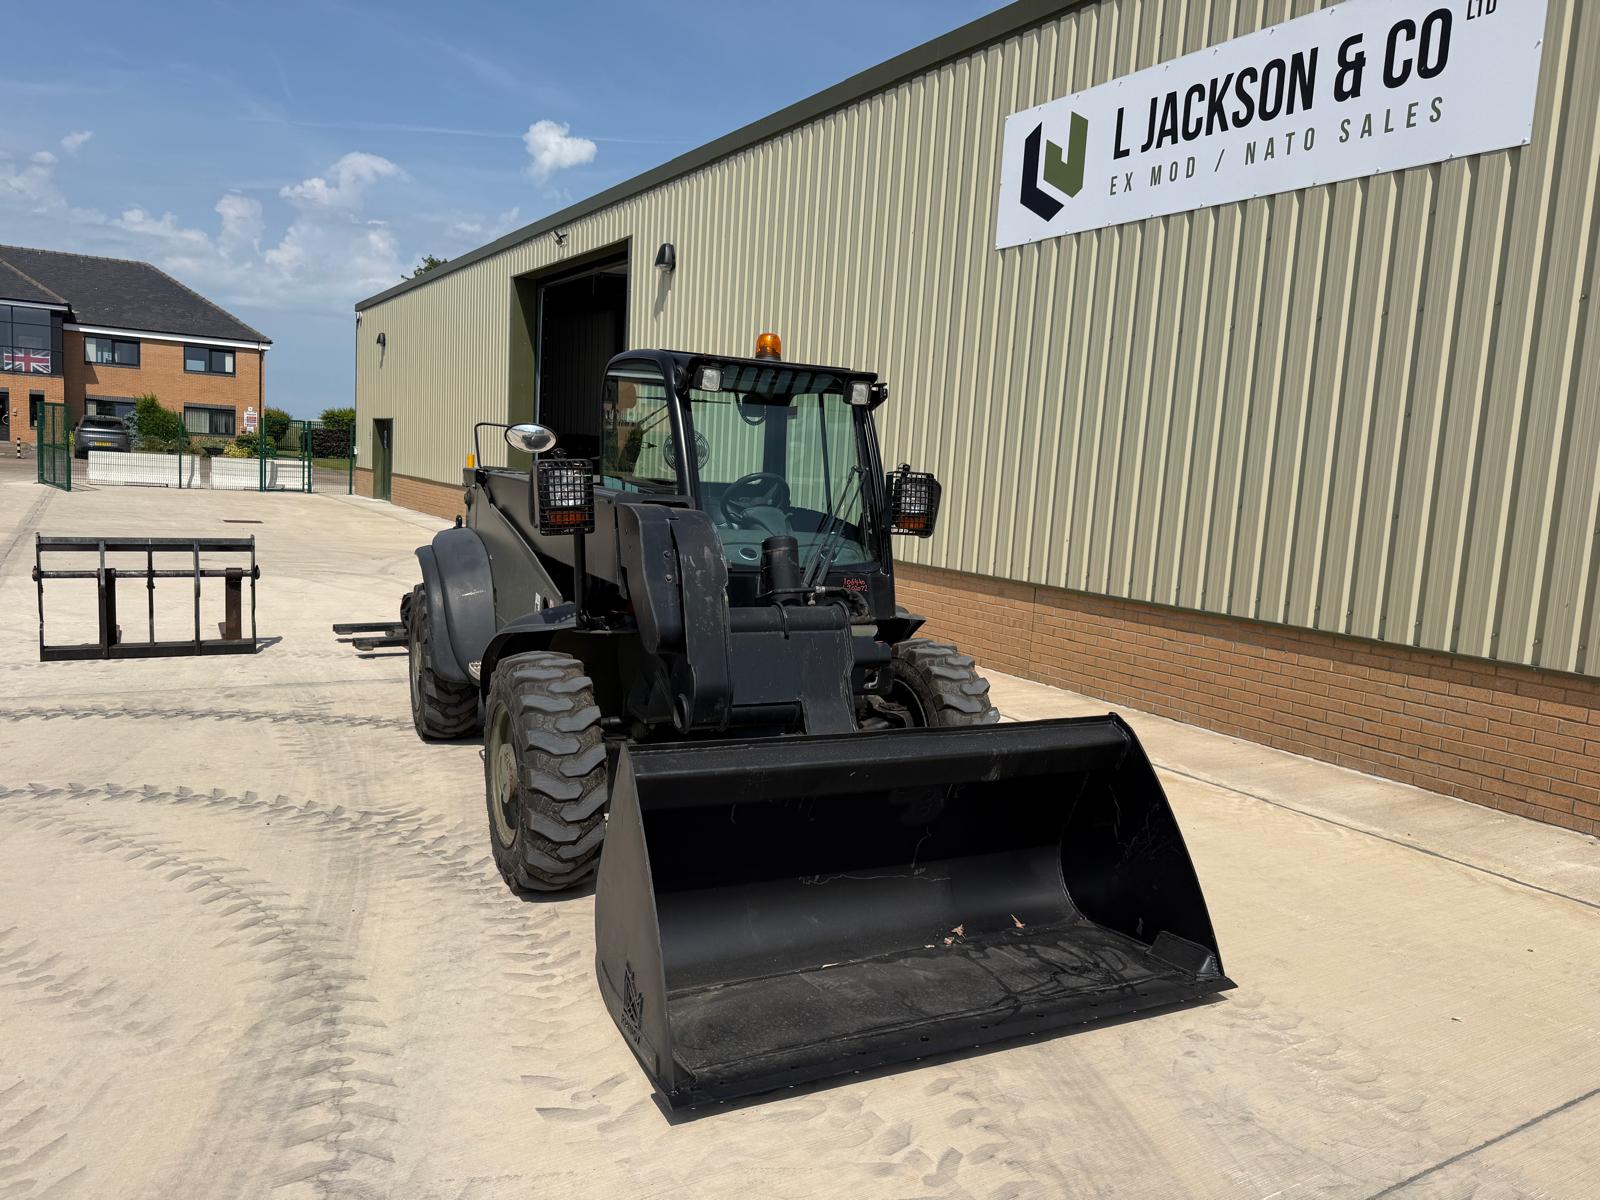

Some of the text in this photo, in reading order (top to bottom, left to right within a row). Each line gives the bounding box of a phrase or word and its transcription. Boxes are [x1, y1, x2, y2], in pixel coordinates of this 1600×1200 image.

[1113, 0, 1498, 161] L JACKSON & CO LTD
[1109, 97, 1443, 196] EX MOD / NATO SALES
